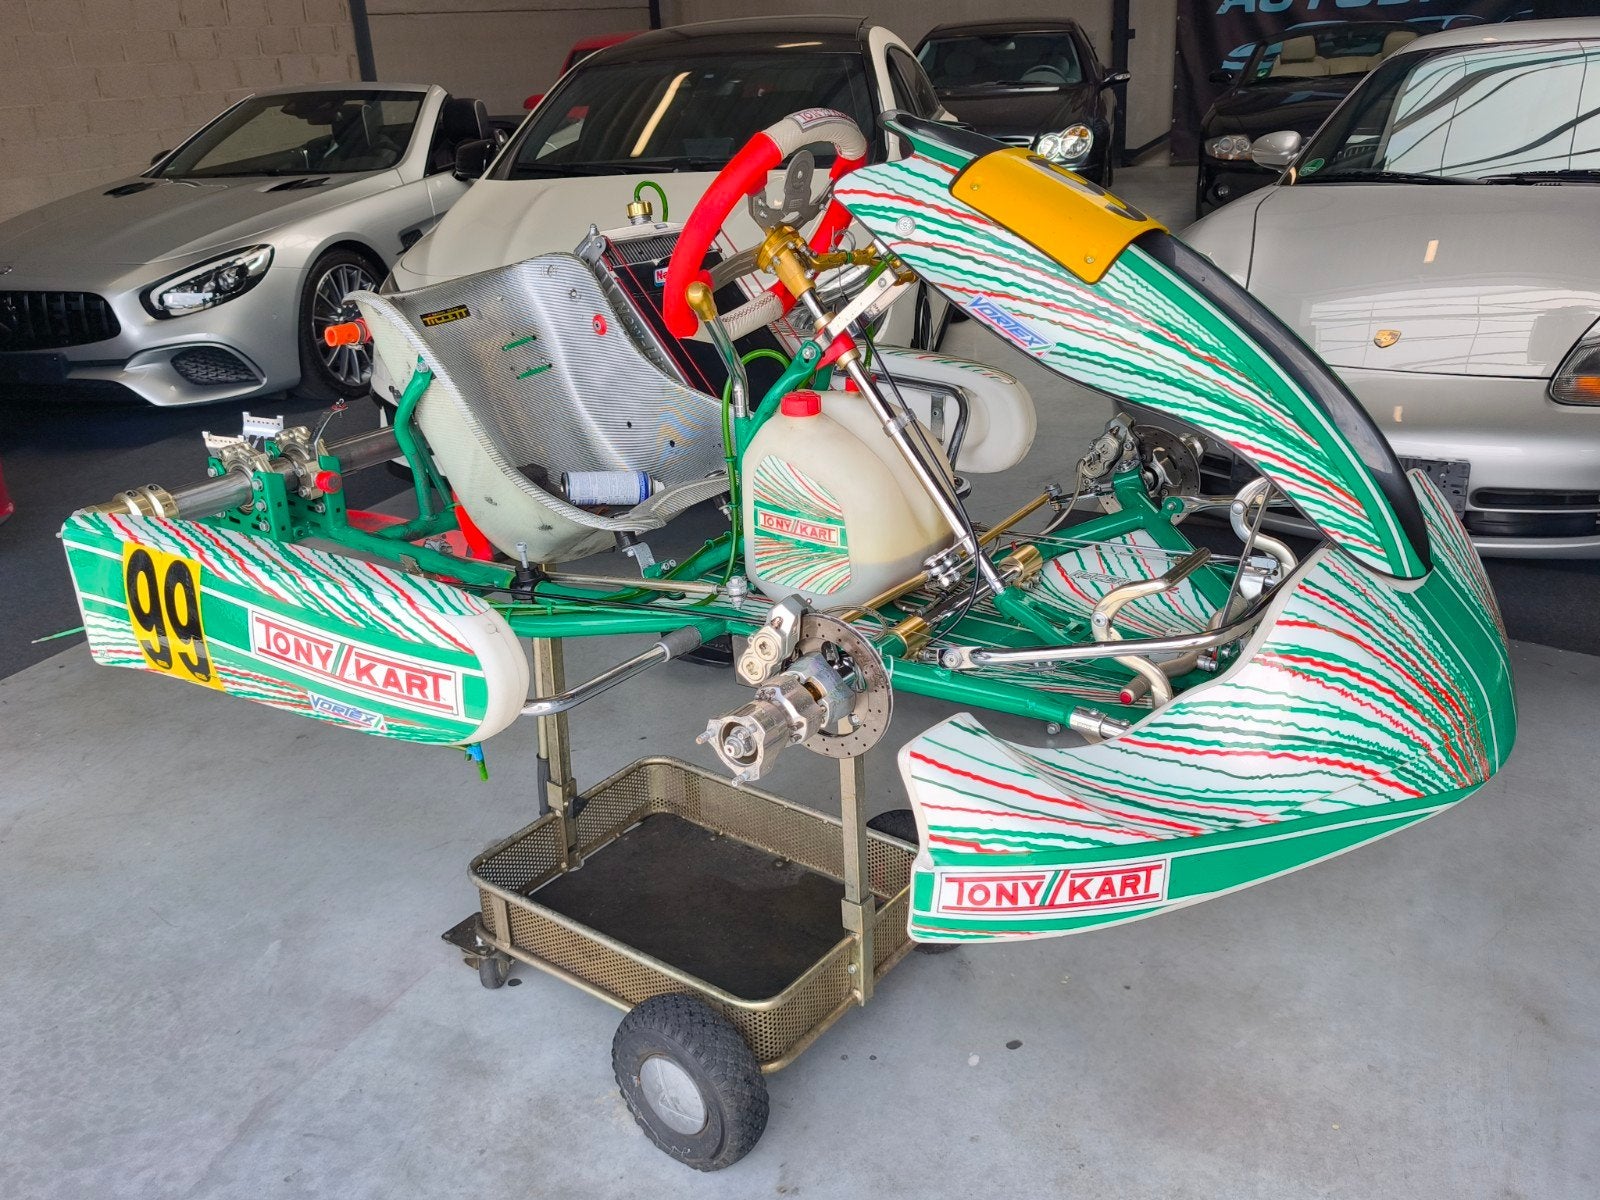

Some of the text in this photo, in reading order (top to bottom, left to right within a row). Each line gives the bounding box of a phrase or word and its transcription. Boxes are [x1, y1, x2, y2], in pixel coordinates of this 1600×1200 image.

[969, 296, 1049, 346] VORTEX
[126, 548, 212, 683] 99
[255, 617, 452, 702] TONY KART
[310, 694, 377, 724] VORTEX
[945, 864, 1163, 906] TONY KART
